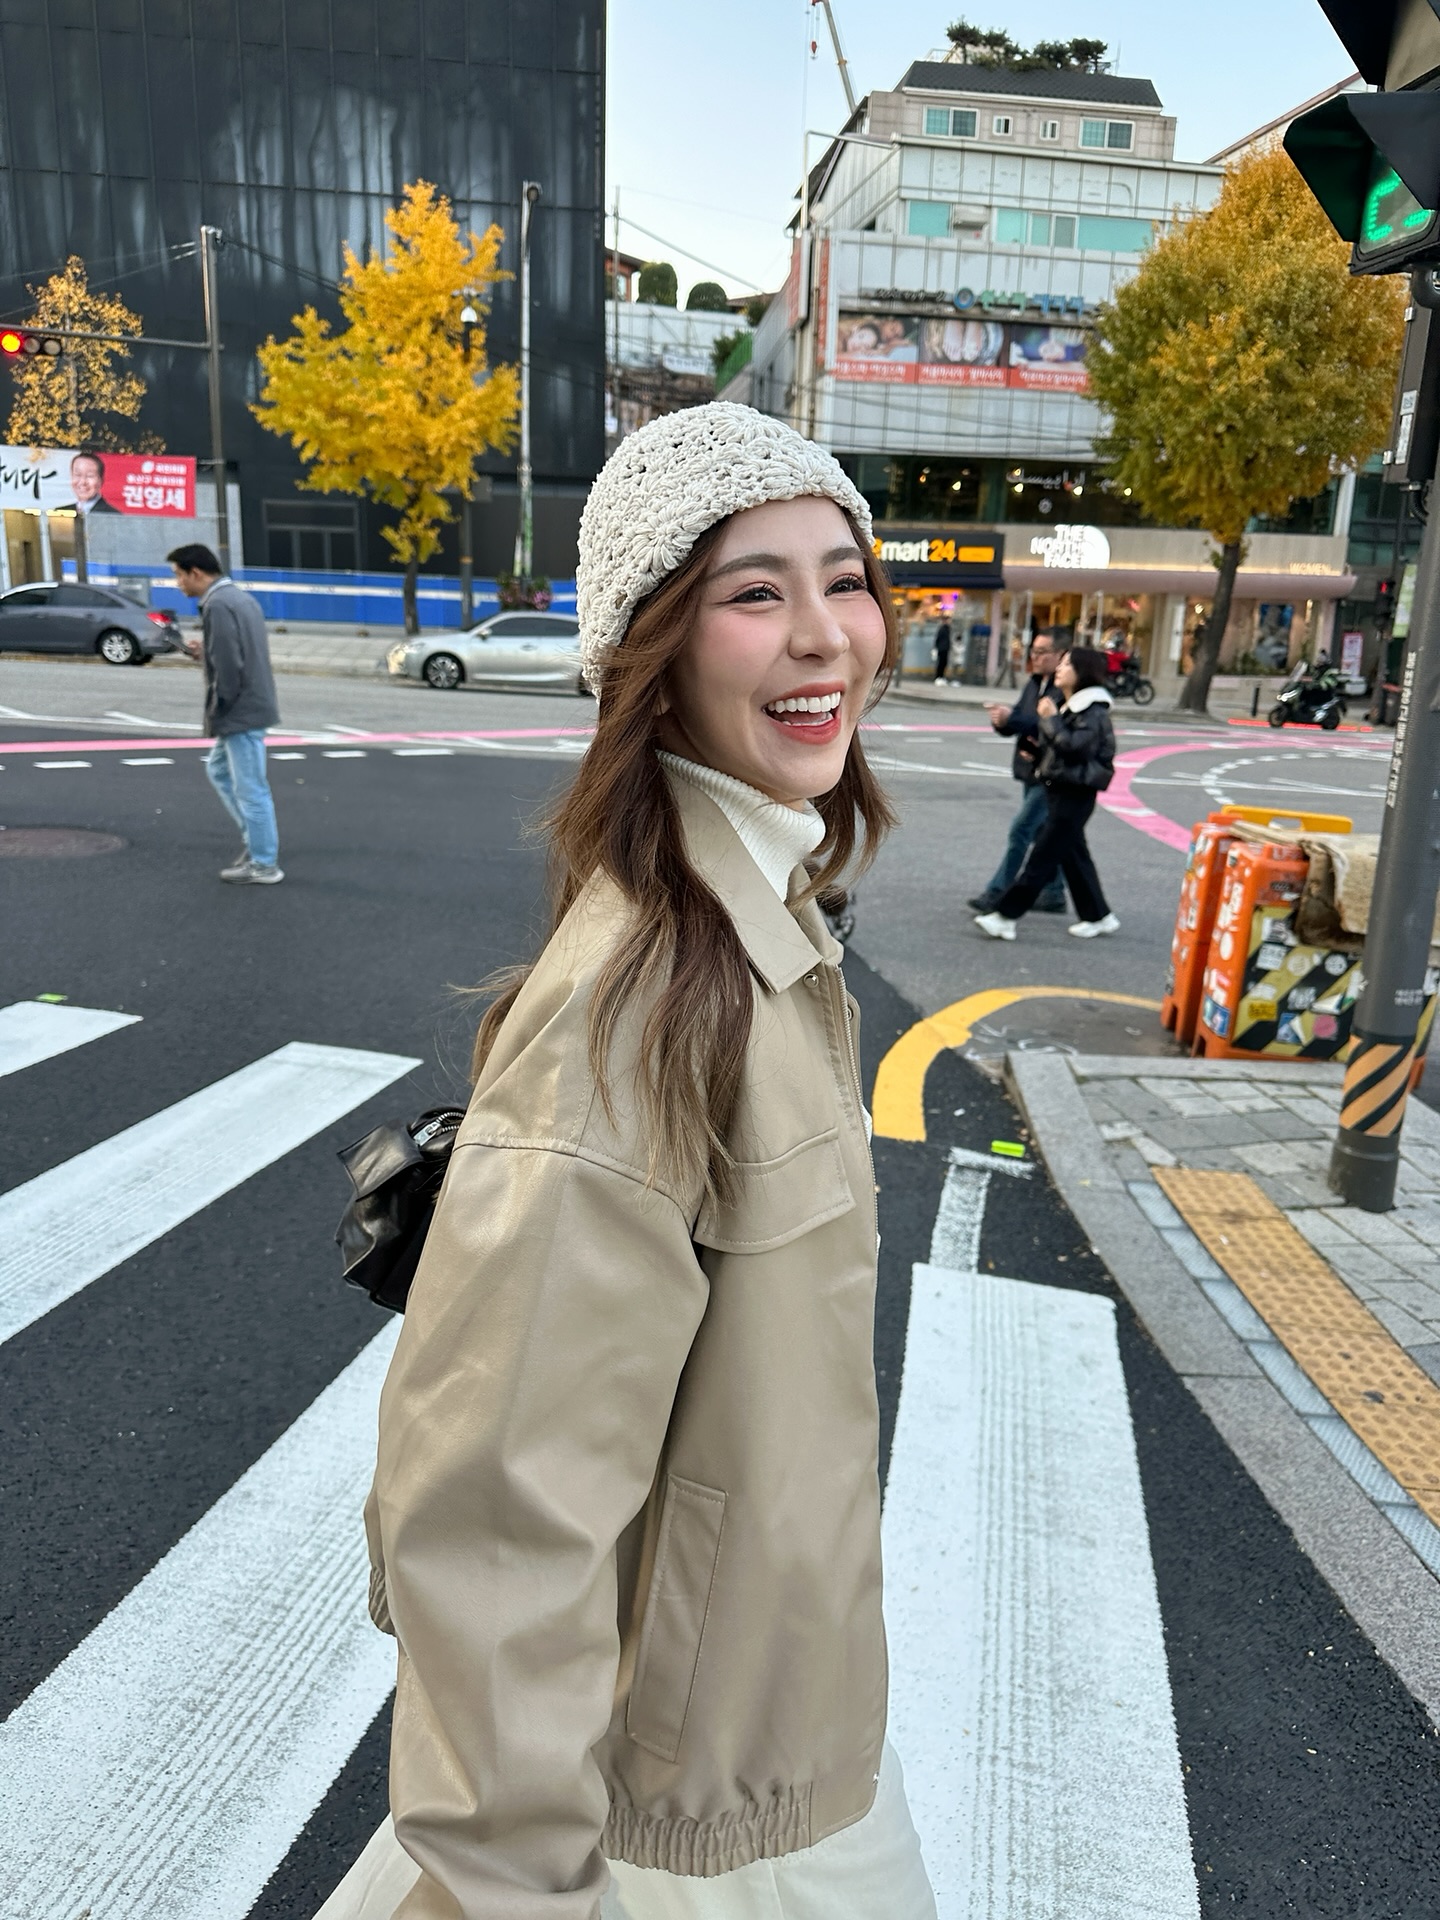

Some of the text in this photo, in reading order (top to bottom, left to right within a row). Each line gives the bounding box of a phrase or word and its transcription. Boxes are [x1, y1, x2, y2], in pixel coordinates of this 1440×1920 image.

[122, 486, 187, 511] 권영세
[1054, 524, 1084, 542] THE
[1030, 536, 1082, 555] NORTH
[1044, 551, 1082, 569] FACE
